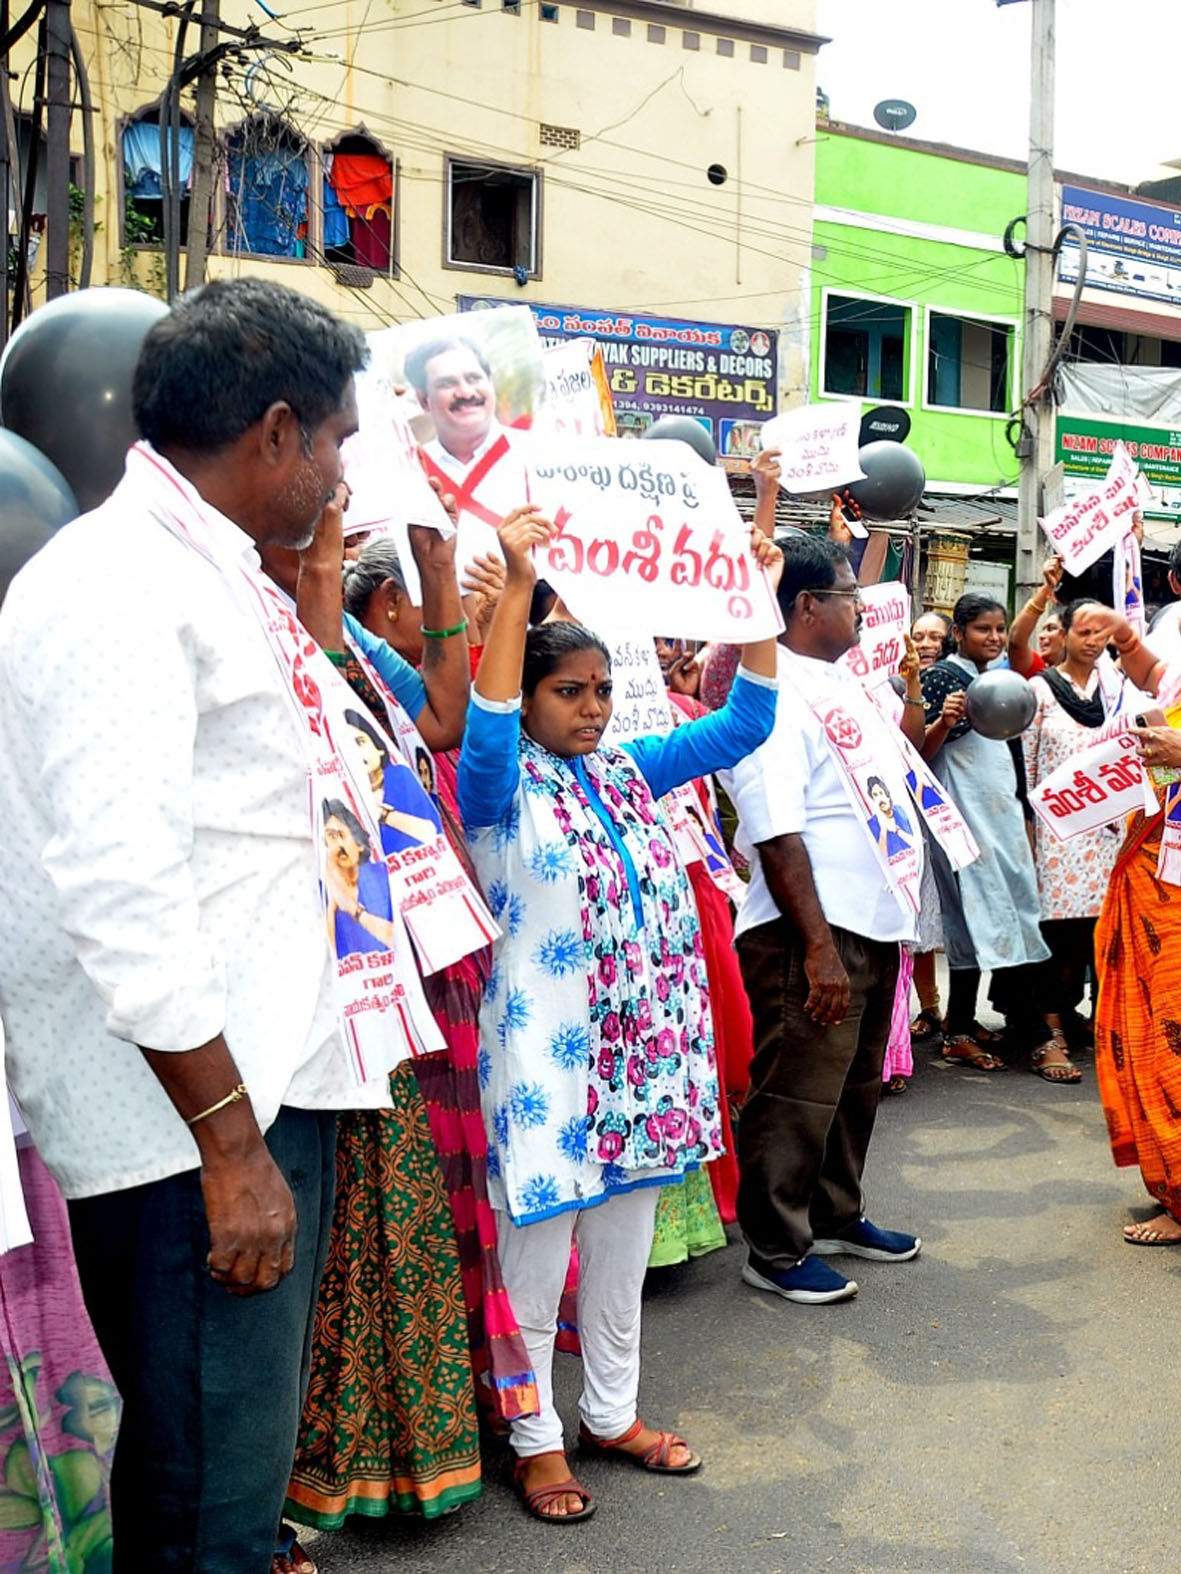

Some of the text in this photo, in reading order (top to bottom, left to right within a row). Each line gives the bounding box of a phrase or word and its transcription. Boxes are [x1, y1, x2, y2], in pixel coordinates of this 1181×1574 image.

[636, 323, 721, 345] వినాయక
[631, 344, 705, 372] SUPPLIERS
[707, 355, 717, 373] &
[719, 353, 773, 379] DECORS
[610, 368, 638, 394] &
[1062, 433, 1098, 453] NIZAM
[1099, 438, 1139, 457] SCES
[548, 505, 753, 619] వంశీ వద్దు
[1042, 769, 1108, 818] వంశీ
